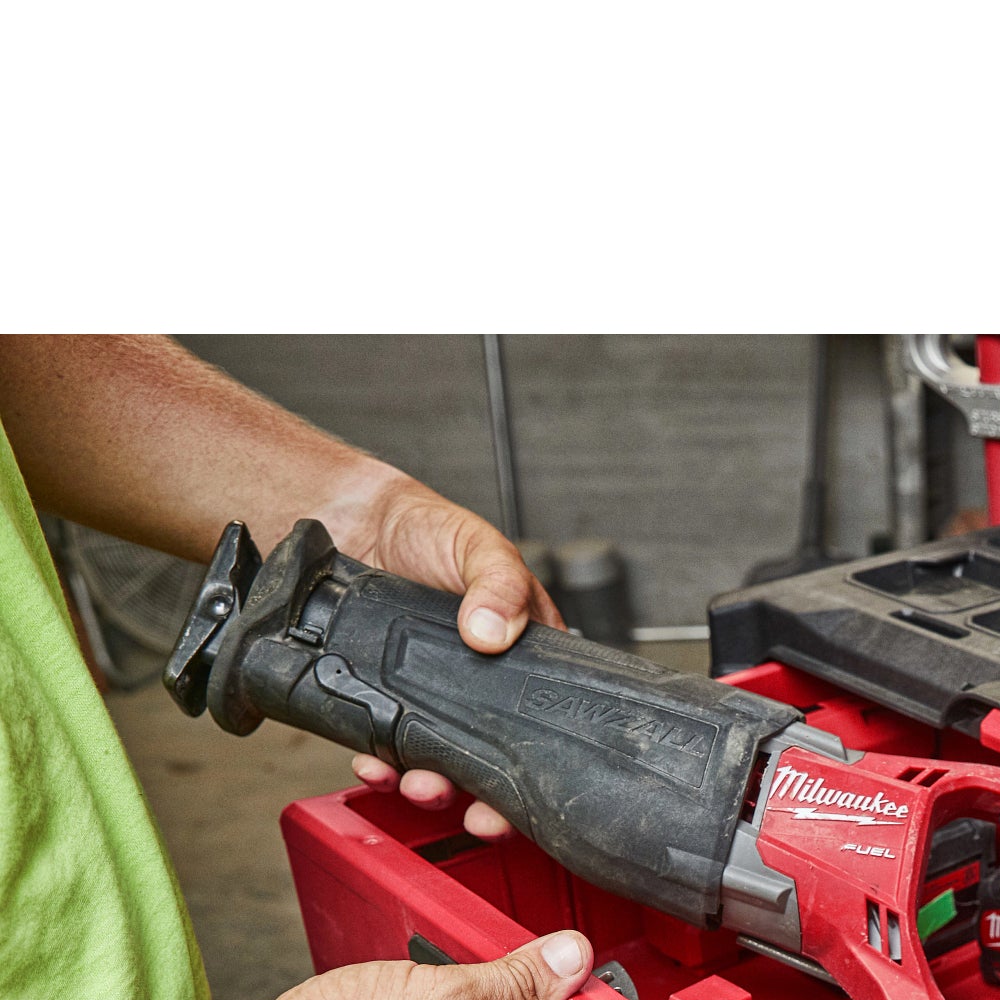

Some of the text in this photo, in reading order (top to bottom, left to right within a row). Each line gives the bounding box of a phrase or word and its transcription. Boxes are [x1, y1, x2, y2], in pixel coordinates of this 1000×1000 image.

[526, 688, 707, 758] SAWZALL
[769, 765, 909, 819] Milwaukee
[841, 843, 896, 859] FUEL
